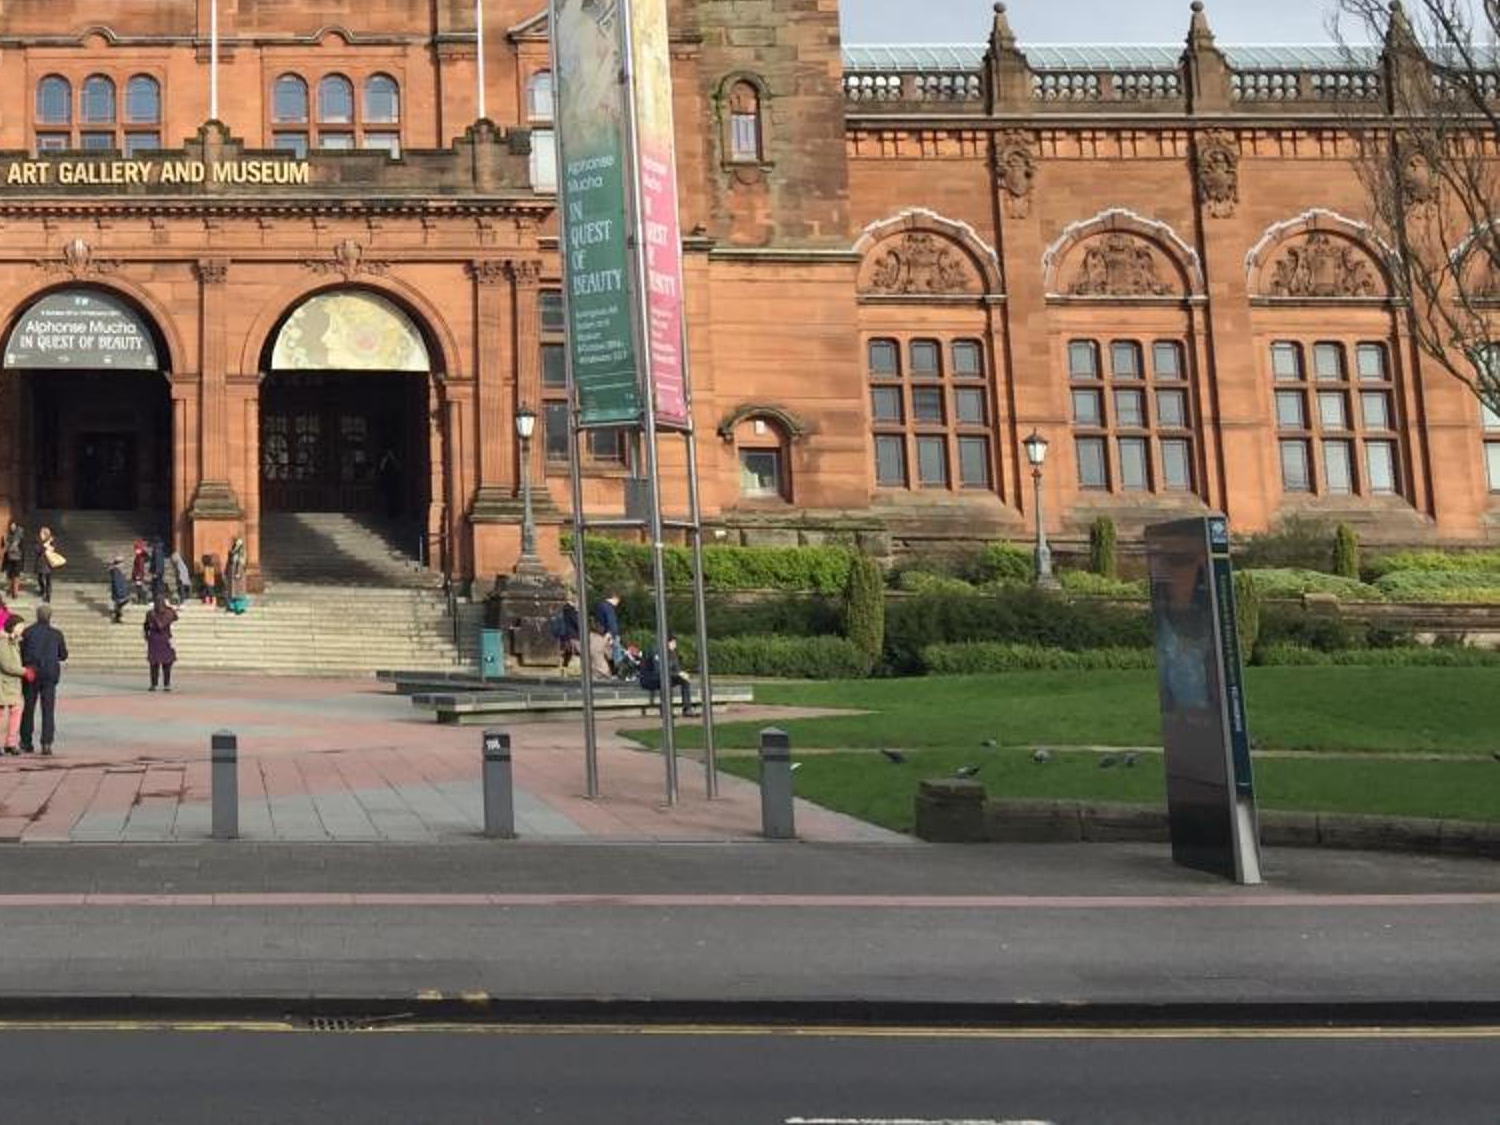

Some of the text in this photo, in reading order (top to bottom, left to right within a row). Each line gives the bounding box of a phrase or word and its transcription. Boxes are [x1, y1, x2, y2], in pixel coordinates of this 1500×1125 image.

[7, 162, 51, 184] ART
[58, 162, 152, 184] GALLERY
[160, 161, 206, 184] AND
[213, 161, 309, 184] MUSEUM
[569, 201, 583, 220] IN
[571, 219, 612, 249] QUEST
[571, 249, 586, 270] OF
[573, 268, 622, 295] BEAUTY
[26, 320, 137, 335] Alphonse Mucha
[20, 335, 143, 351] IN QUEST OF BEAUTY
